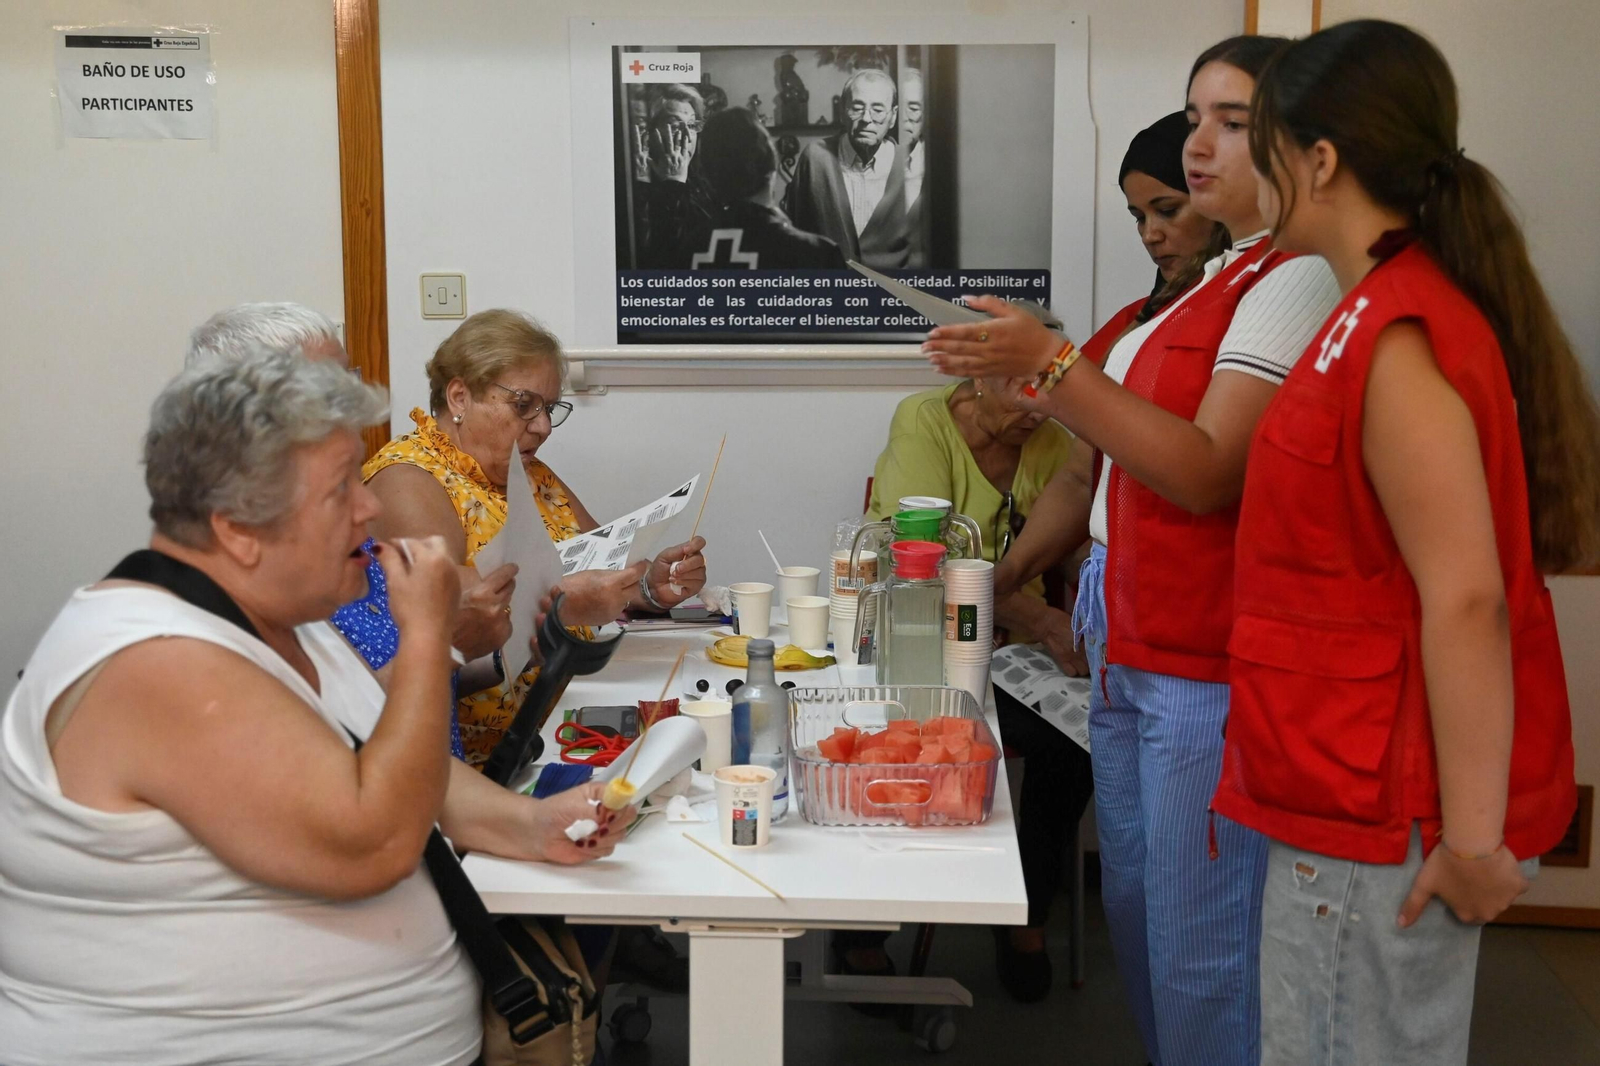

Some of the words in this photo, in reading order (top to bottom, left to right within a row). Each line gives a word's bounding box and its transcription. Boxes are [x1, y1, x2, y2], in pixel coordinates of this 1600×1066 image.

[82, 61, 126, 78] BAÑO
[130, 65, 150, 78] DE
[154, 65, 186, 79] USO
[648, 63, 671, 72] Cruz
[672, 62, 694, 73] Roja
[81, 97, 194, 112] PARTICIPANTES
[620, 276, 644, 288] Los
[646, 275, 709, 288] cuidados
[711, 278, 736, 288] son
[739, 275, 811, 288] esenciales
[813, 278, 831, 288] en
[892, 275, 956, 288] ociedad.
[959, 275, 1030, 288] Posibilitar
[1032, 275, 1045, 288] el
[620, 294, 687, 307] bienestar
[697, 294, 715, 307] de
[726, 294, 746, 307] las
[757, 294, 833, 307] cuidadoras
[844, 297, 869, 307] con
[620, 313, 707, 326] emocionales
[709, 316, 726, 326] es
[728, 313, 797, 326] fortalecer
[799, 313, 812, 326] el
[815, 313, 881, 326] bienestar
